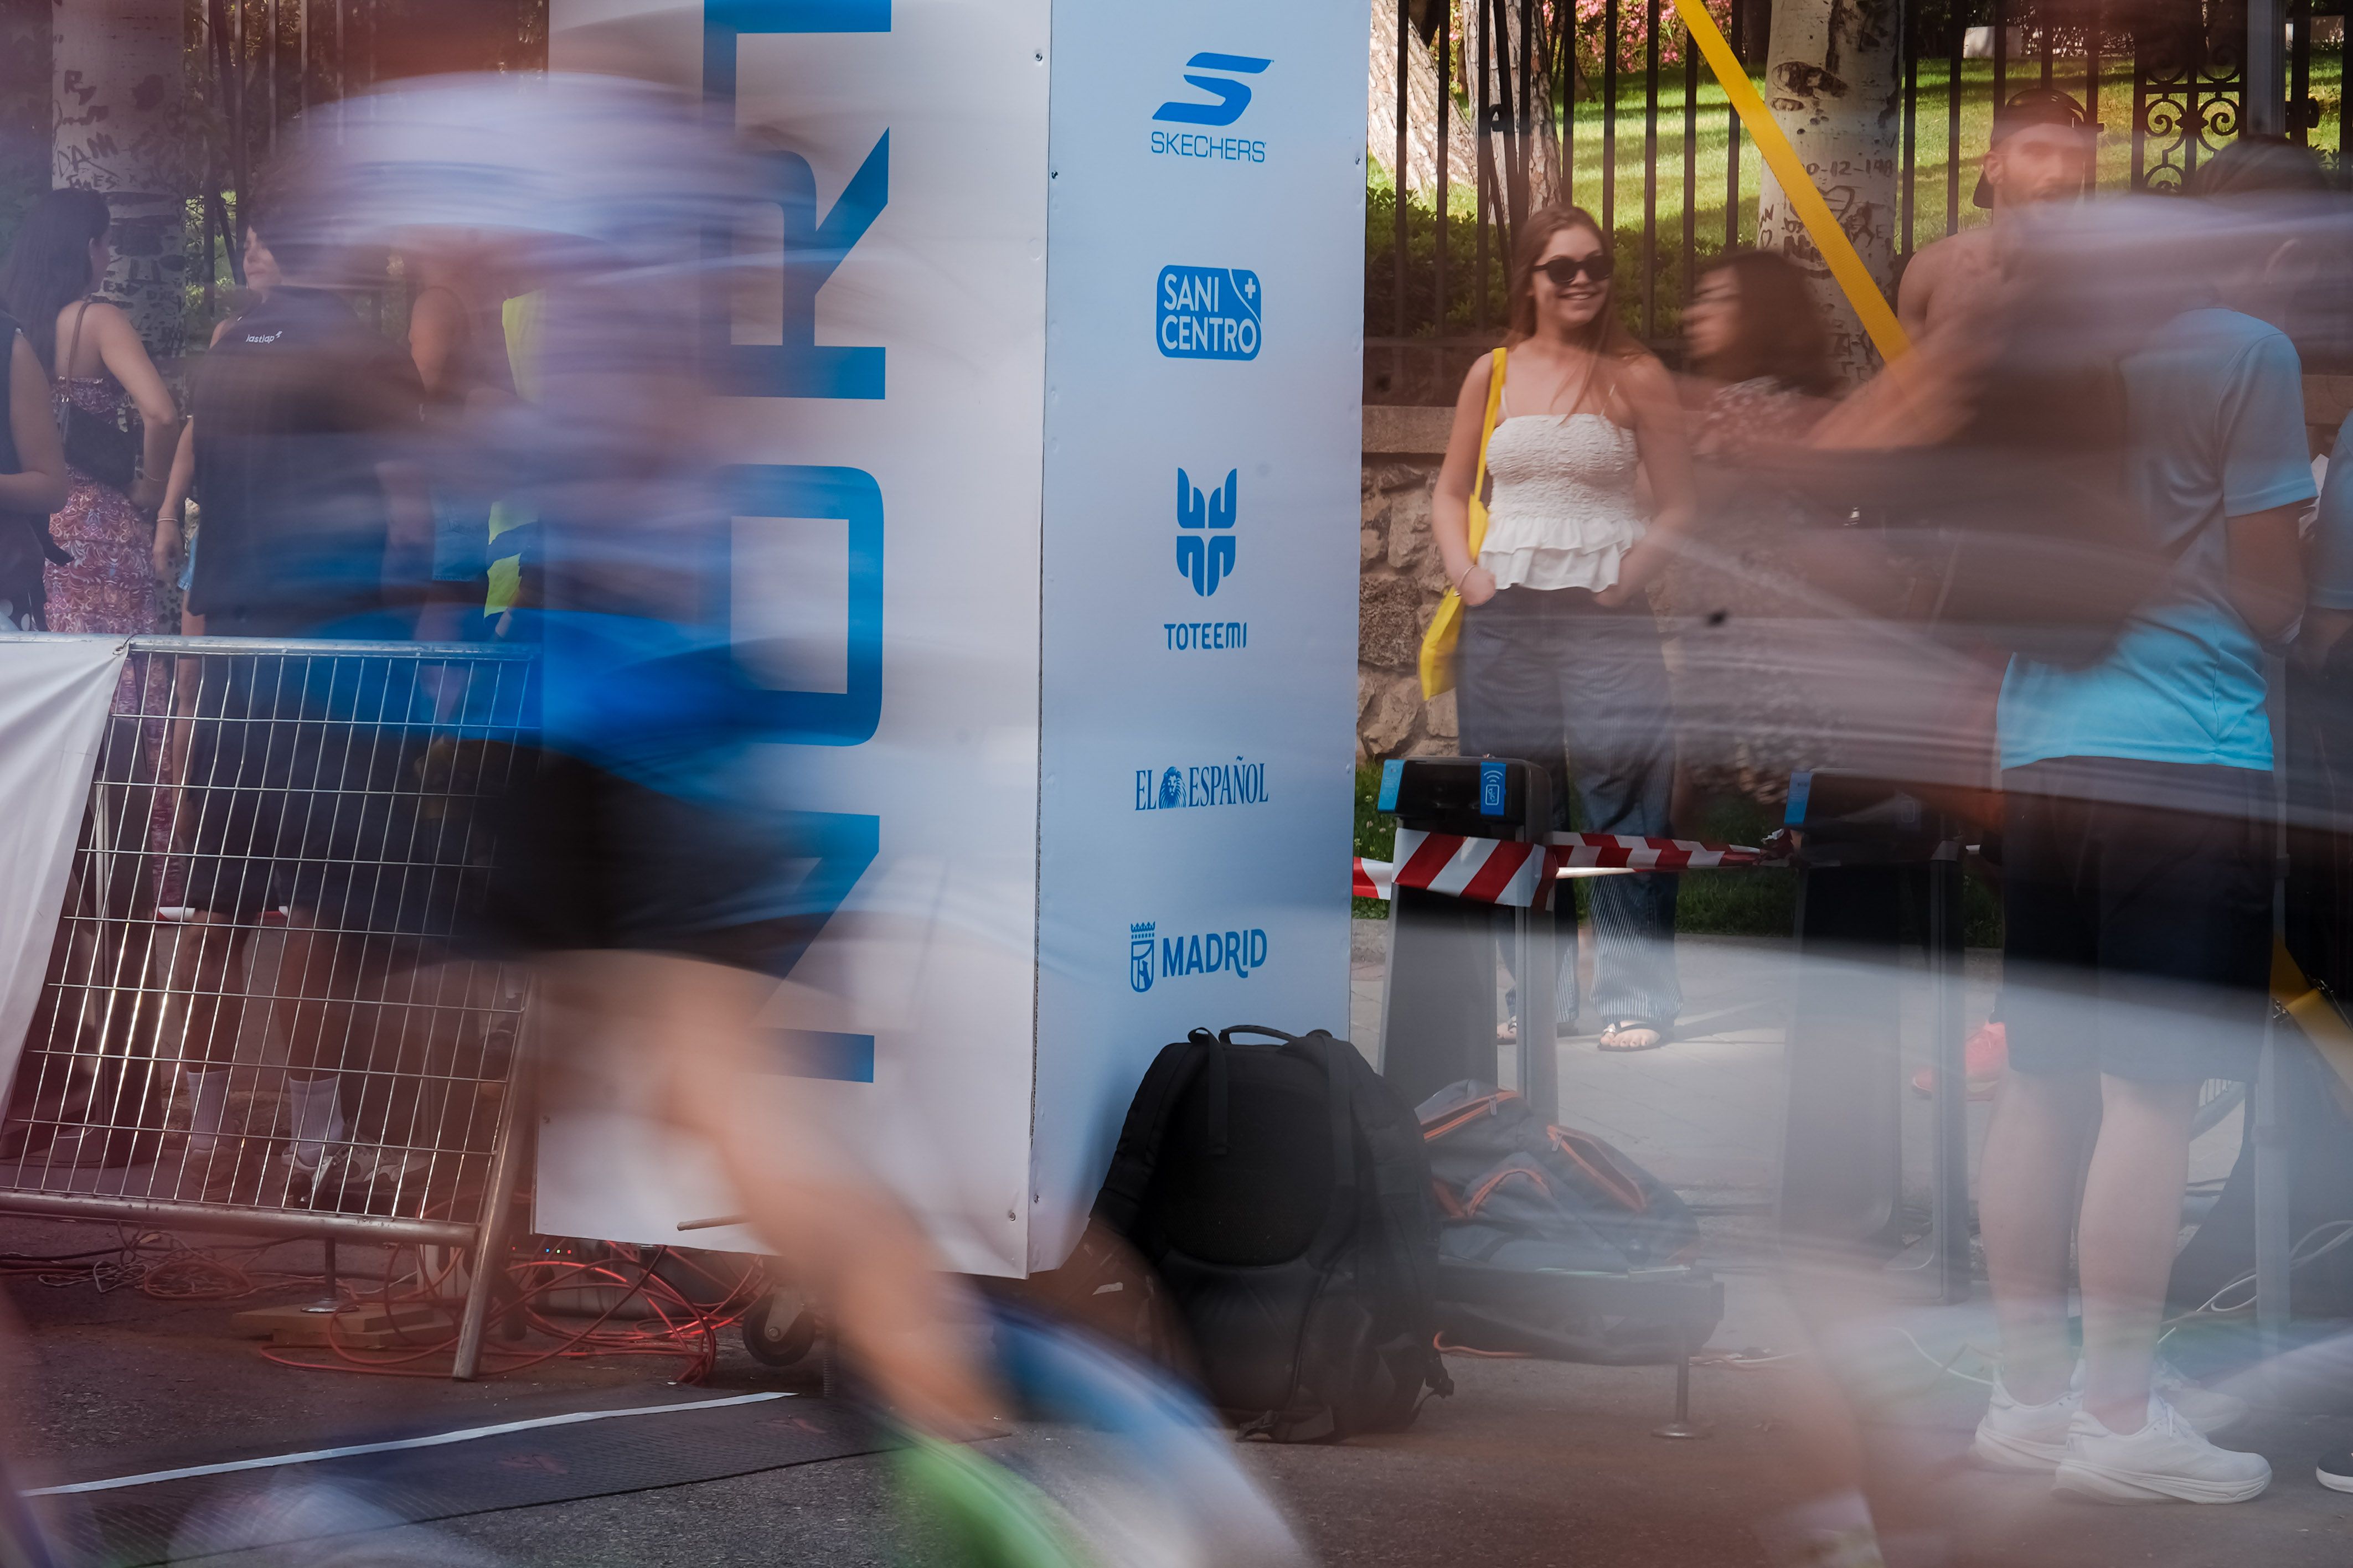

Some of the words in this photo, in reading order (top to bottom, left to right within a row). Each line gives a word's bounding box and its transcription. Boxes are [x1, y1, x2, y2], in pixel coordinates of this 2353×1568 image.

[1151, 131, 1266, 163] SKECHERS
[1164, 273, 1219, 312] SANI
[245, 334, 275, 344] lastlap
[1162, 315, 1257, 354] CENTRO
[1164, 622, 1247, 651] TOTEEMI
[1135, 769, 1157, 811] EL
[1188, 755, 1269, 808] ESPAÑOL
[1162, 928, 1268, 979] MADRID
